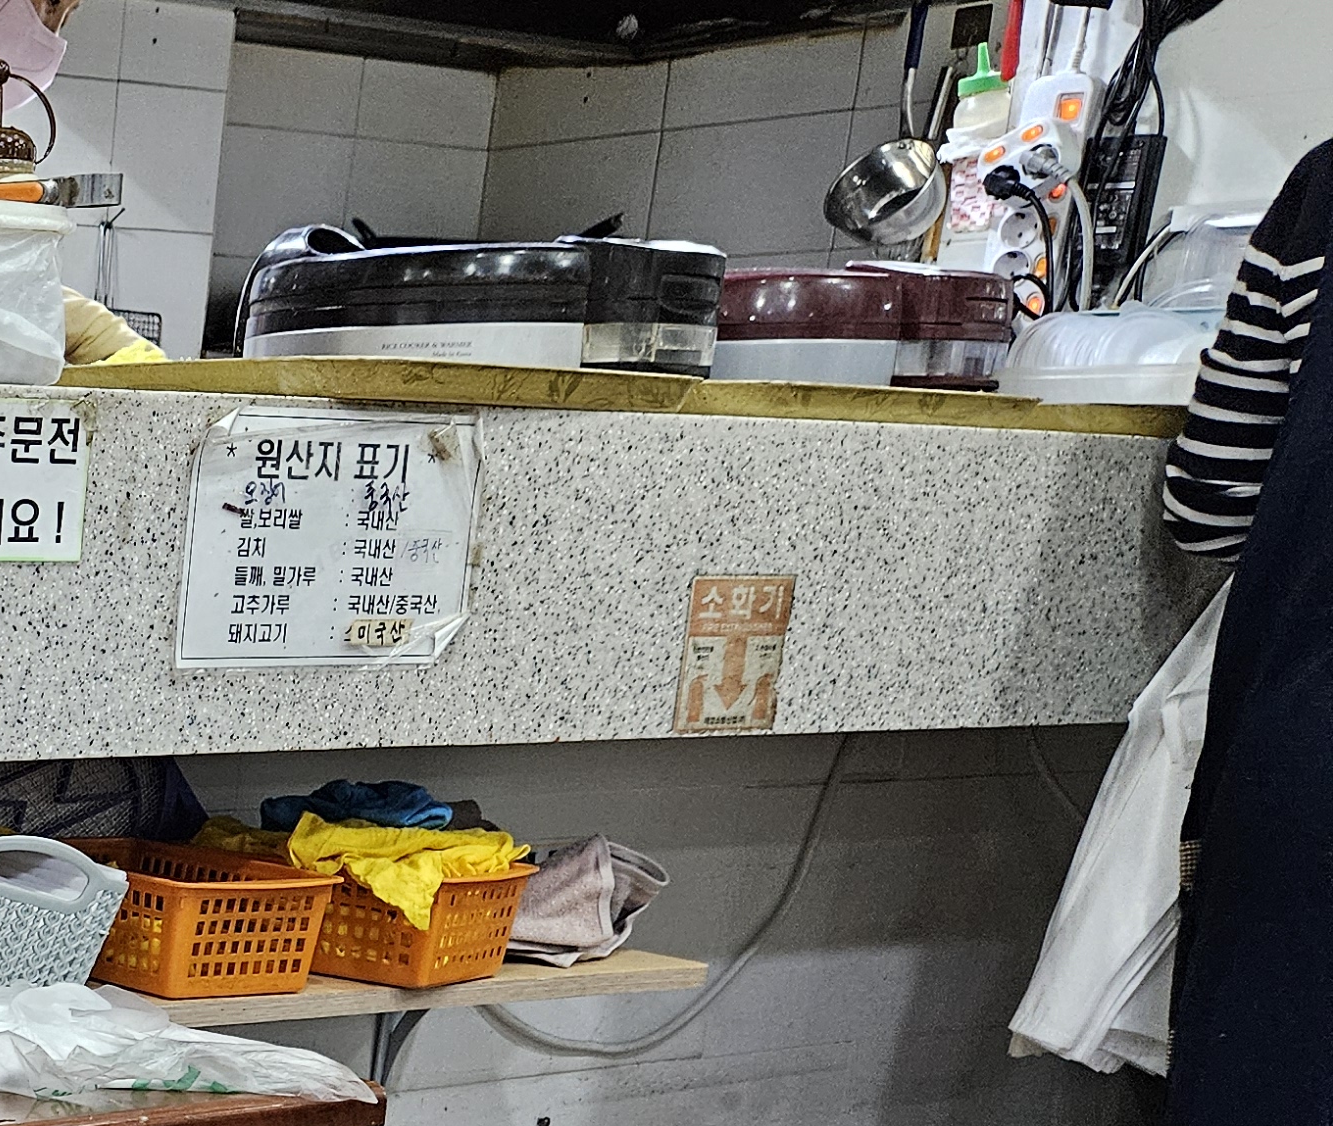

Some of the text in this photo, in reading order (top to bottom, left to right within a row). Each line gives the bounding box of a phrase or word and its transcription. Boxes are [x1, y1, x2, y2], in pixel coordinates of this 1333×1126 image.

[254, 438, 410, 483] 원산지 표기
[239, 507, 400, 531] 쌀,보리쌀 국내산
[236, 537, 396, 559] 김치 국내산
[272, 566, 317, 587] 밀가루
[350, 566, 393, 587] 국내산
[230, 594, 437, 615] 고추가루 국내산/중국산
[697, 584, 785, 620] 소화기
[227, 622, 288, 644] 돼지고기
[357, 621, 405, 646] 미국산
